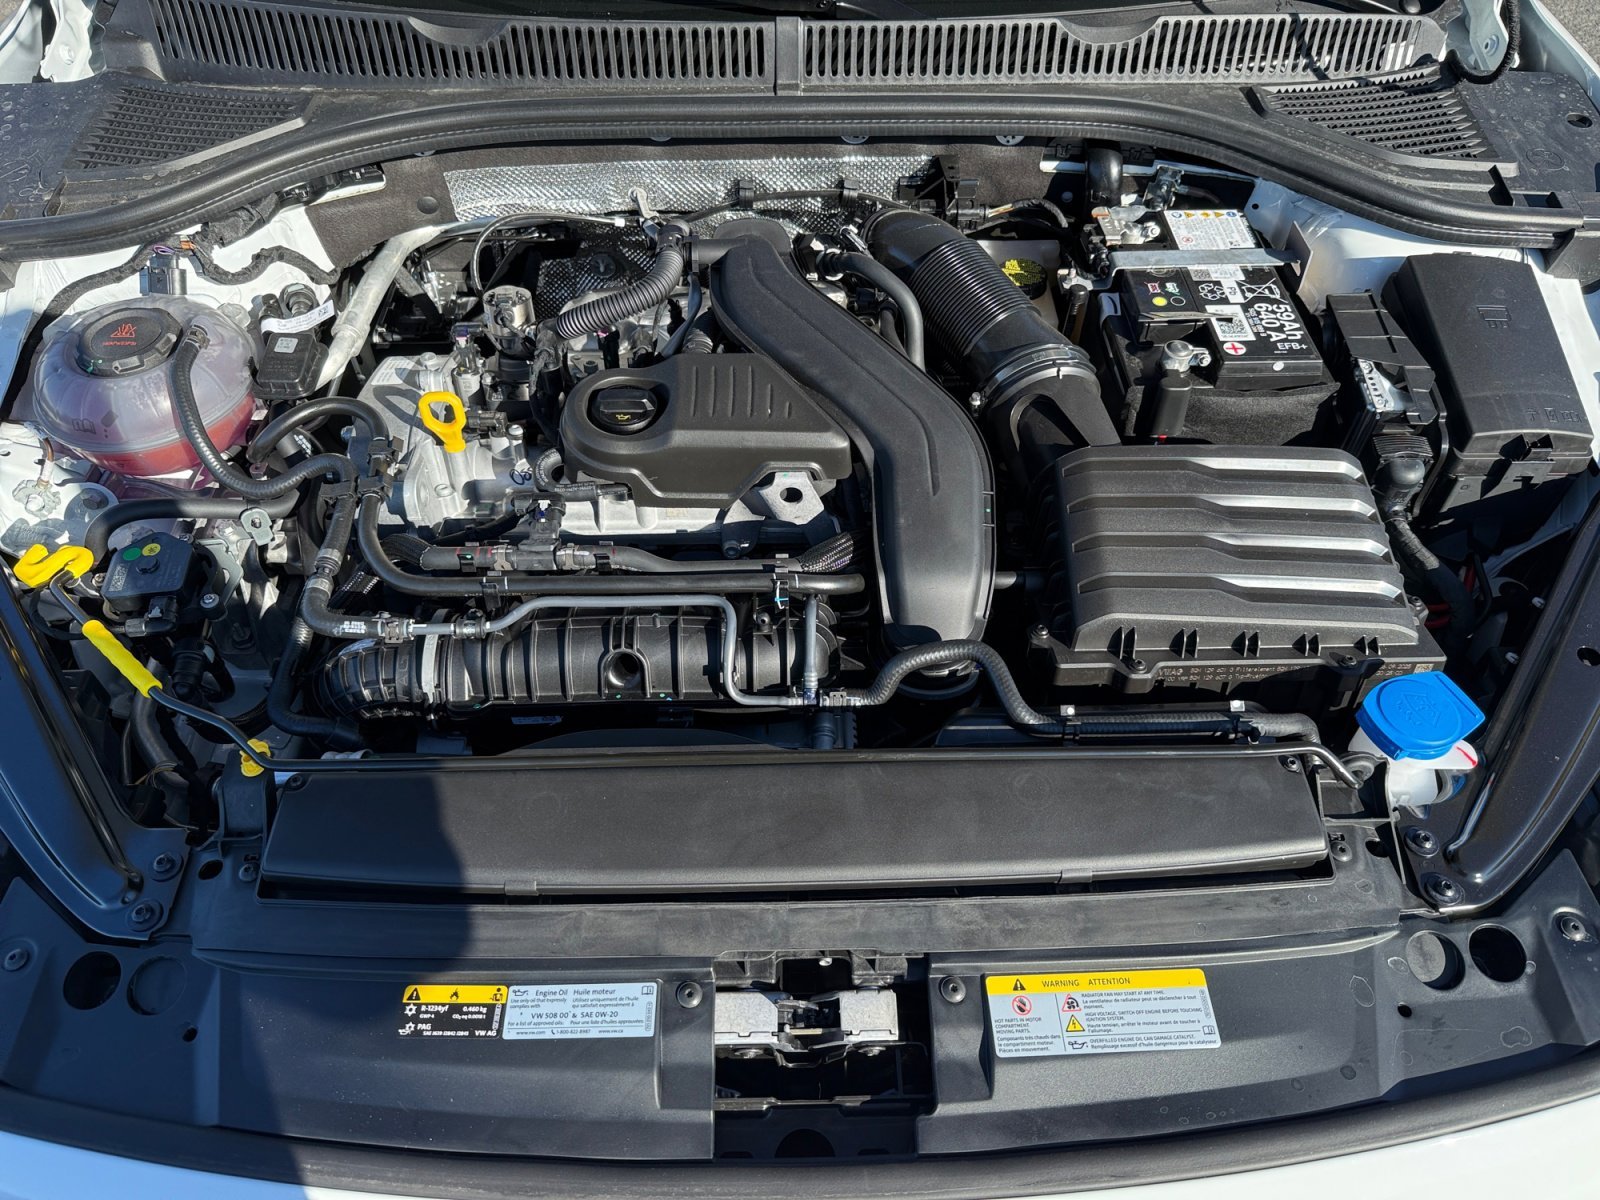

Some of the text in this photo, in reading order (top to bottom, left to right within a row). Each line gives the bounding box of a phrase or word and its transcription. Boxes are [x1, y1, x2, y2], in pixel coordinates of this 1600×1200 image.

[1254, 303, 1281, 327] 640
[1273, 304, 1304, 340] 59Ah
[1266, 331, 1287, 342] A
[1277, 342, 1308, 350] EFB+
[1041, 976, 1131, 988] WARNING ATTENTION
[535, 989, 558, 998] Engine
[573, 988, 591, 996] Huile
[421, 1005, 449, 1013] R-1234yf
[594, 1010, 619, 1018] 0W-20
[417, 1023, 432, 1031] PAG
